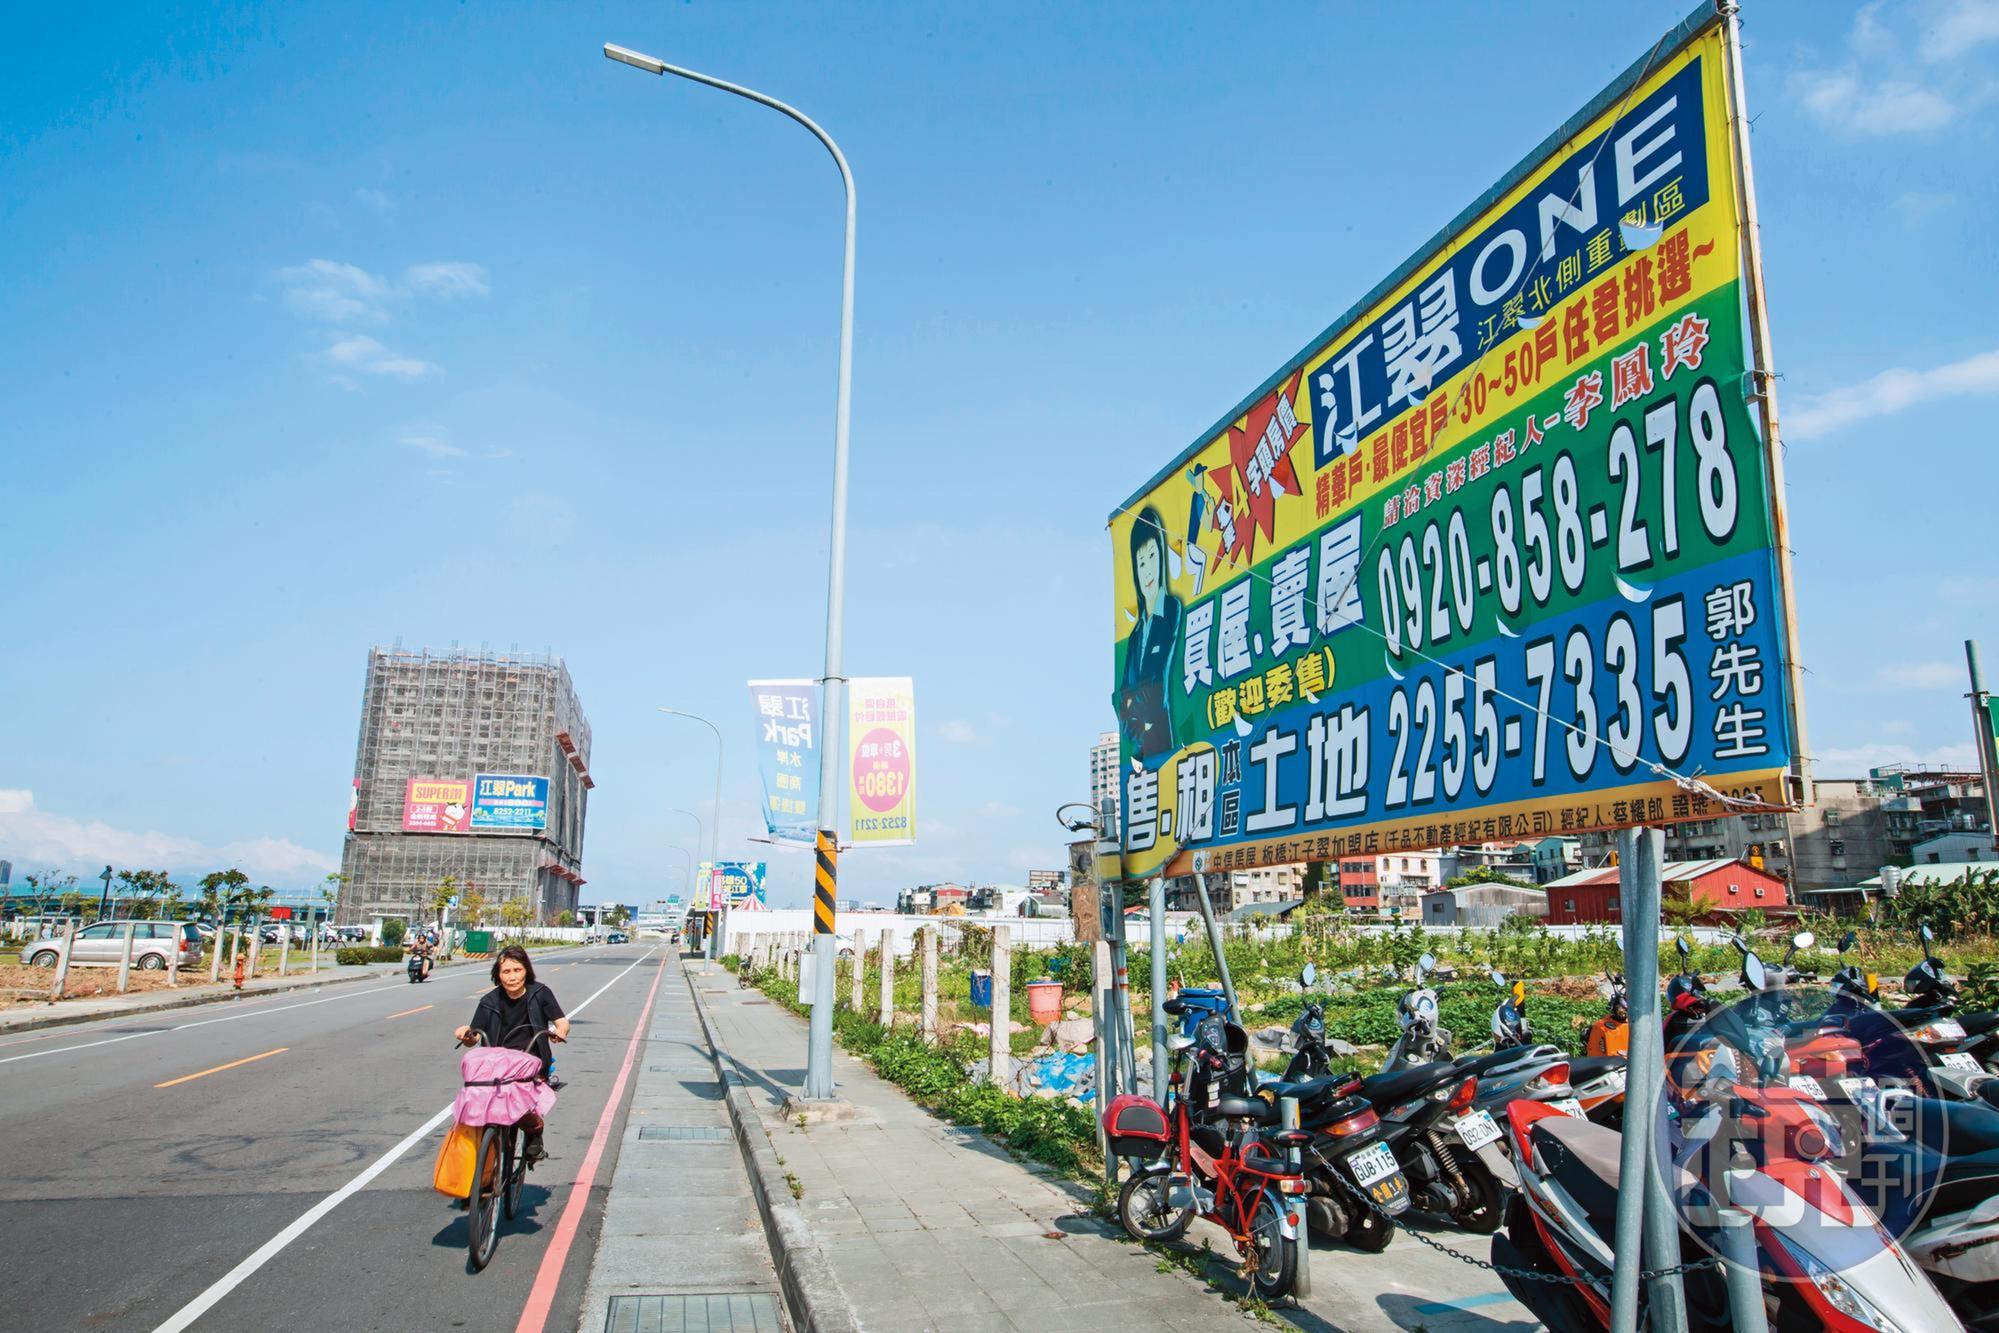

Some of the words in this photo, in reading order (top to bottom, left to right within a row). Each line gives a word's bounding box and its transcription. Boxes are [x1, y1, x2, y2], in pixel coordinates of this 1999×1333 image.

[1377, 382, 1738, 656] 0920-858-278
[1246, 706, 1368, 831] 土地
[1385, 600, 1692, 806] 2255-7335
[1705, 581, 1767, 758] 郭先生
[1220, 738, 1242, 838] 本區
